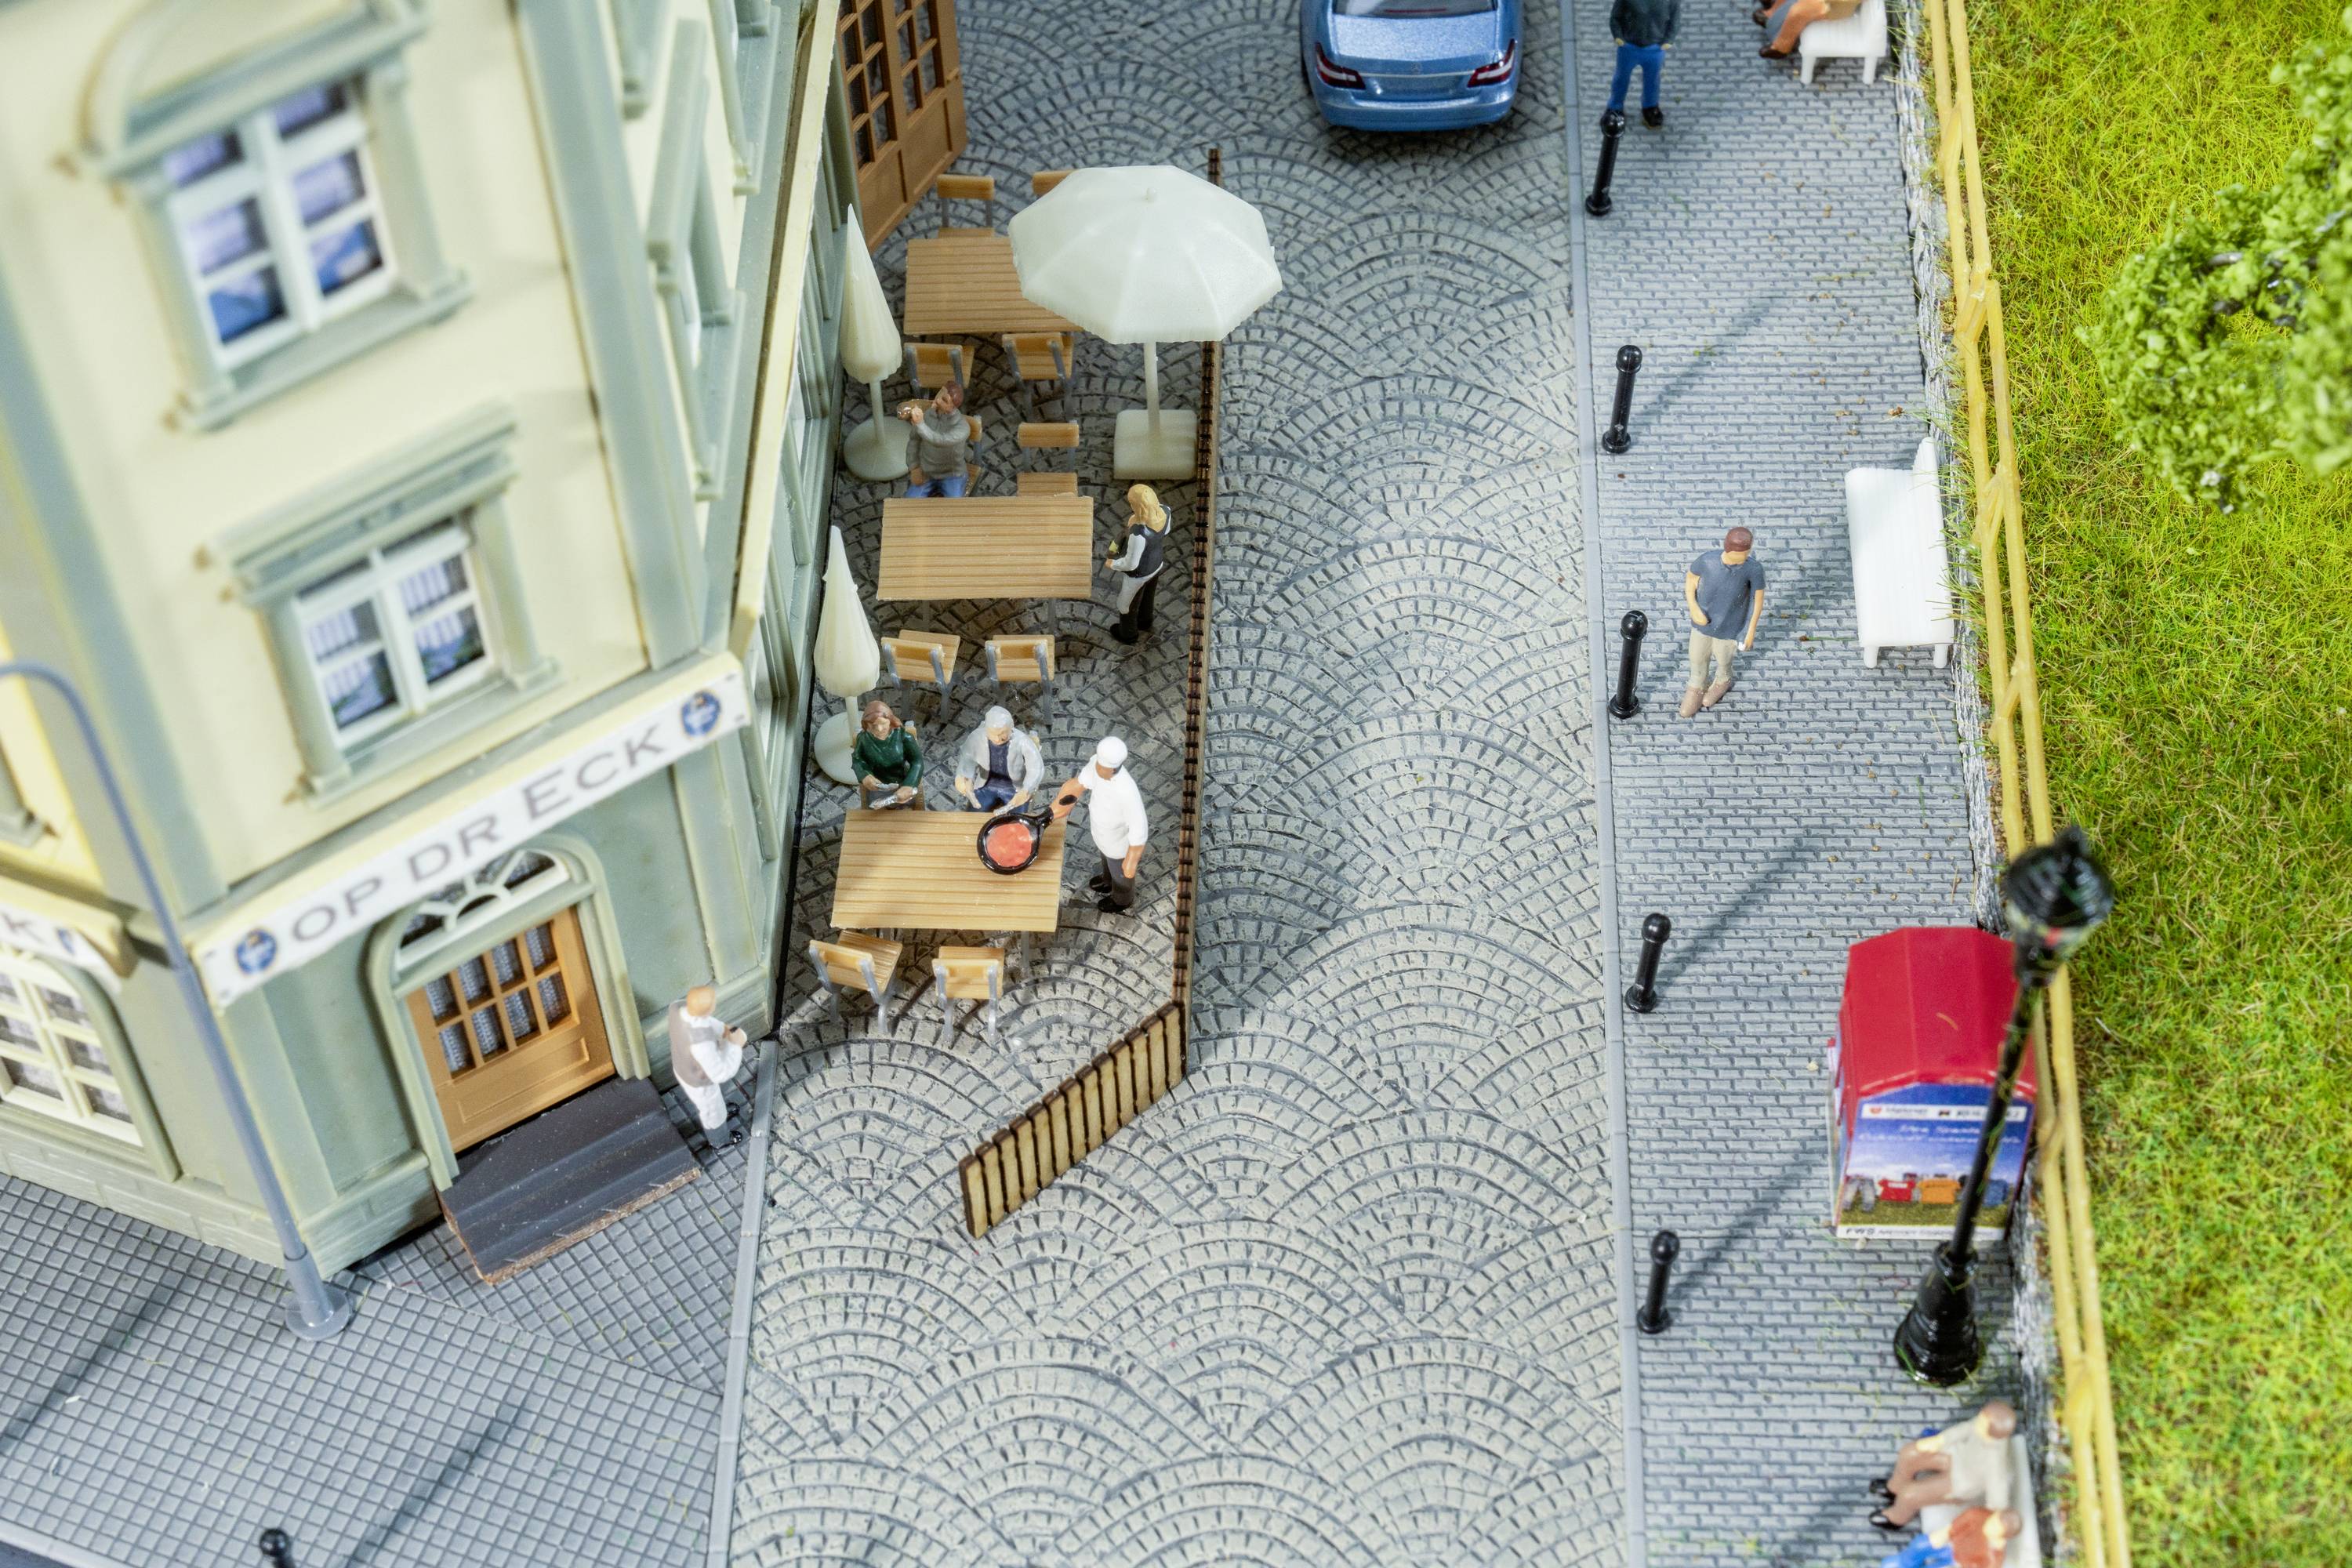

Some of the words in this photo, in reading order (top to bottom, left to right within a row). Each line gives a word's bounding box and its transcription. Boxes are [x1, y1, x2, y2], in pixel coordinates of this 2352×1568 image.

[292, 877, 382, 942] OP
[408, 814, 499, 882] DR
[522, 723, 665, 821] ECK
